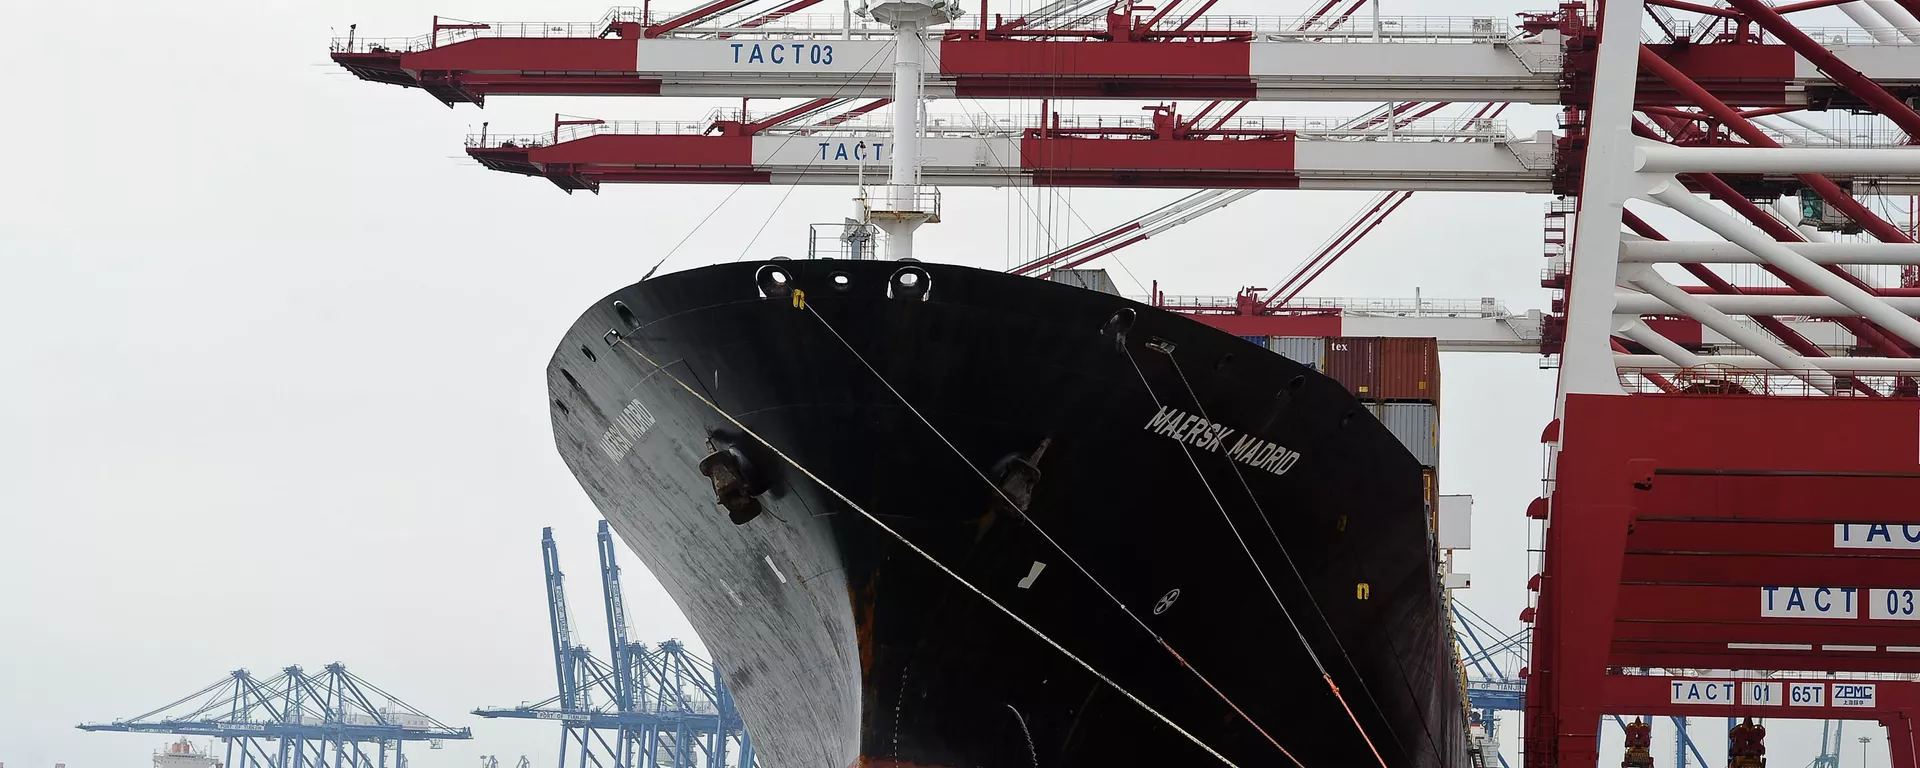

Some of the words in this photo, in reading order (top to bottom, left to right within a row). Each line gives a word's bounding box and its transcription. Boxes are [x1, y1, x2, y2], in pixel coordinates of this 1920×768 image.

[1331, 341, 1348, 351] tex
[1144, 405, 1235, 452] MAERSK
[1227, 434, 1300, 476] MADRID
[1763, 587, 1856, 612] TACT
[1887, 590, 1914, 615] 03
[1672, 683, 1733, 700] TACT
[1754, 685, 1769, 701] 01
[1792, 686, 1822, 703] 65T
[1835, 686, 1872, 699] ZPMC
